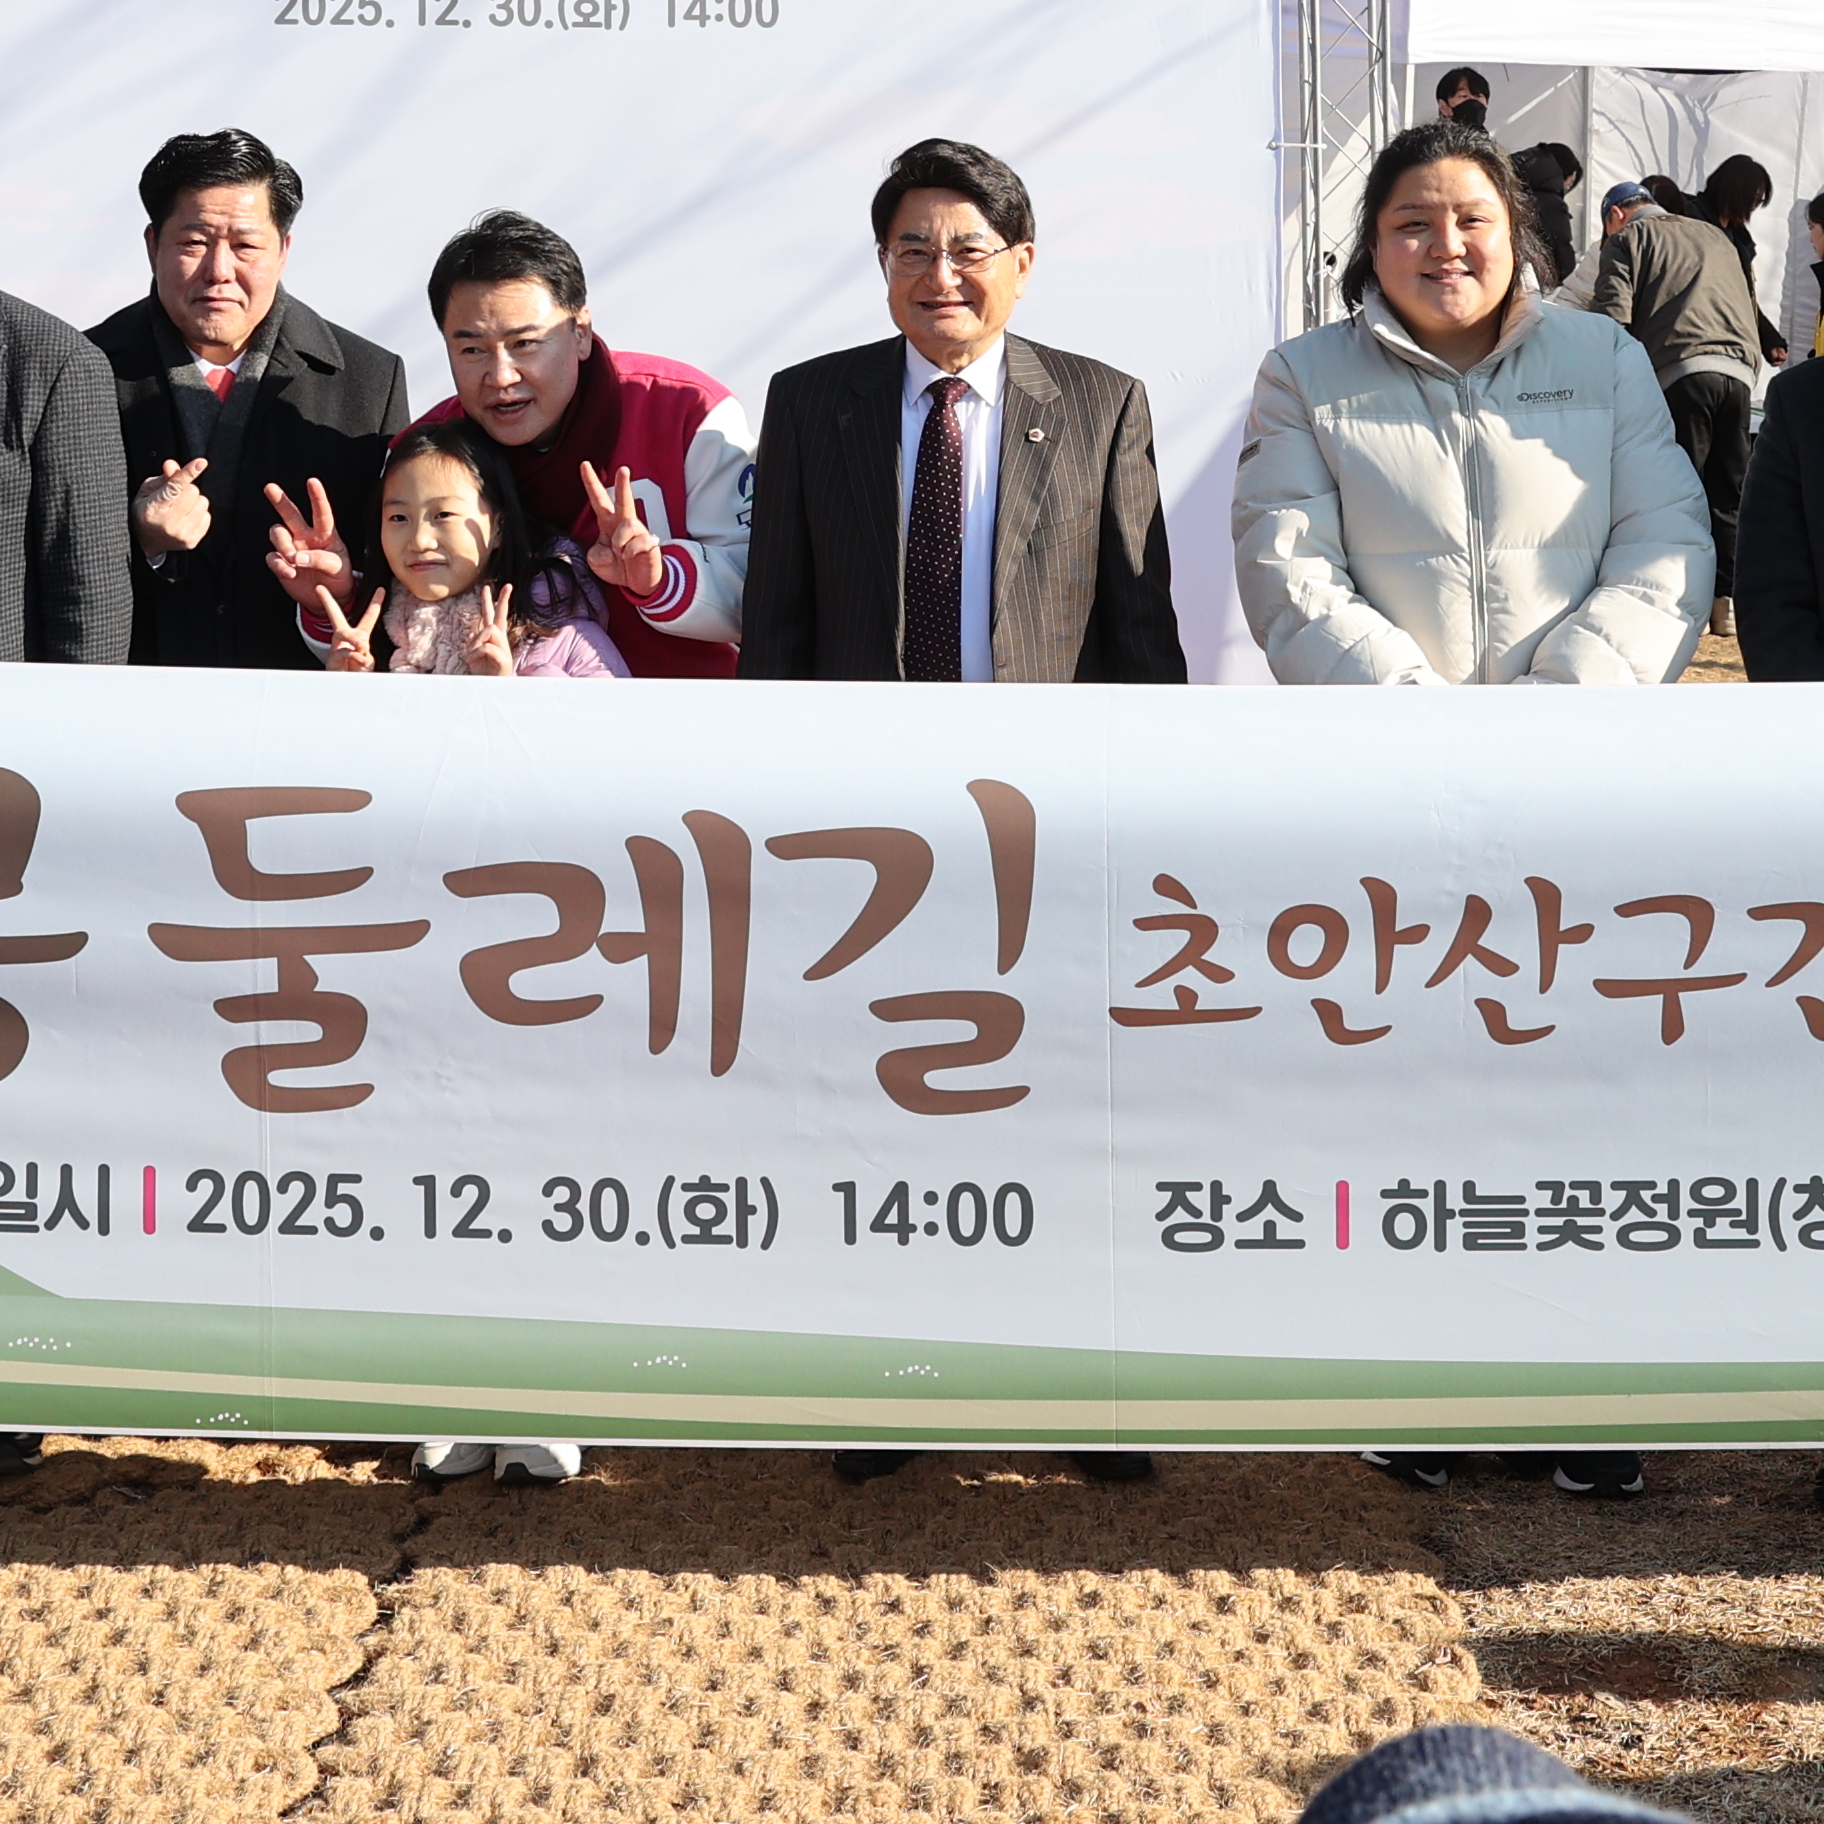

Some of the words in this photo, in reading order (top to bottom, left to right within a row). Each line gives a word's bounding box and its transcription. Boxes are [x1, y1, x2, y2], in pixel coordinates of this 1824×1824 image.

[1518, 389, 1574, 402] Discovery
[147, 779, 1035, 1115] 둘레길
[185, 1169, 384, 1241] 2025.
[412, 1174, 512, 1244] 12.
[541, 1175, 779, 1251] 30.(화)
[832, 1181, 1033, 1247] 14:00
[1155, 1179, 1306, 1253] 장소
